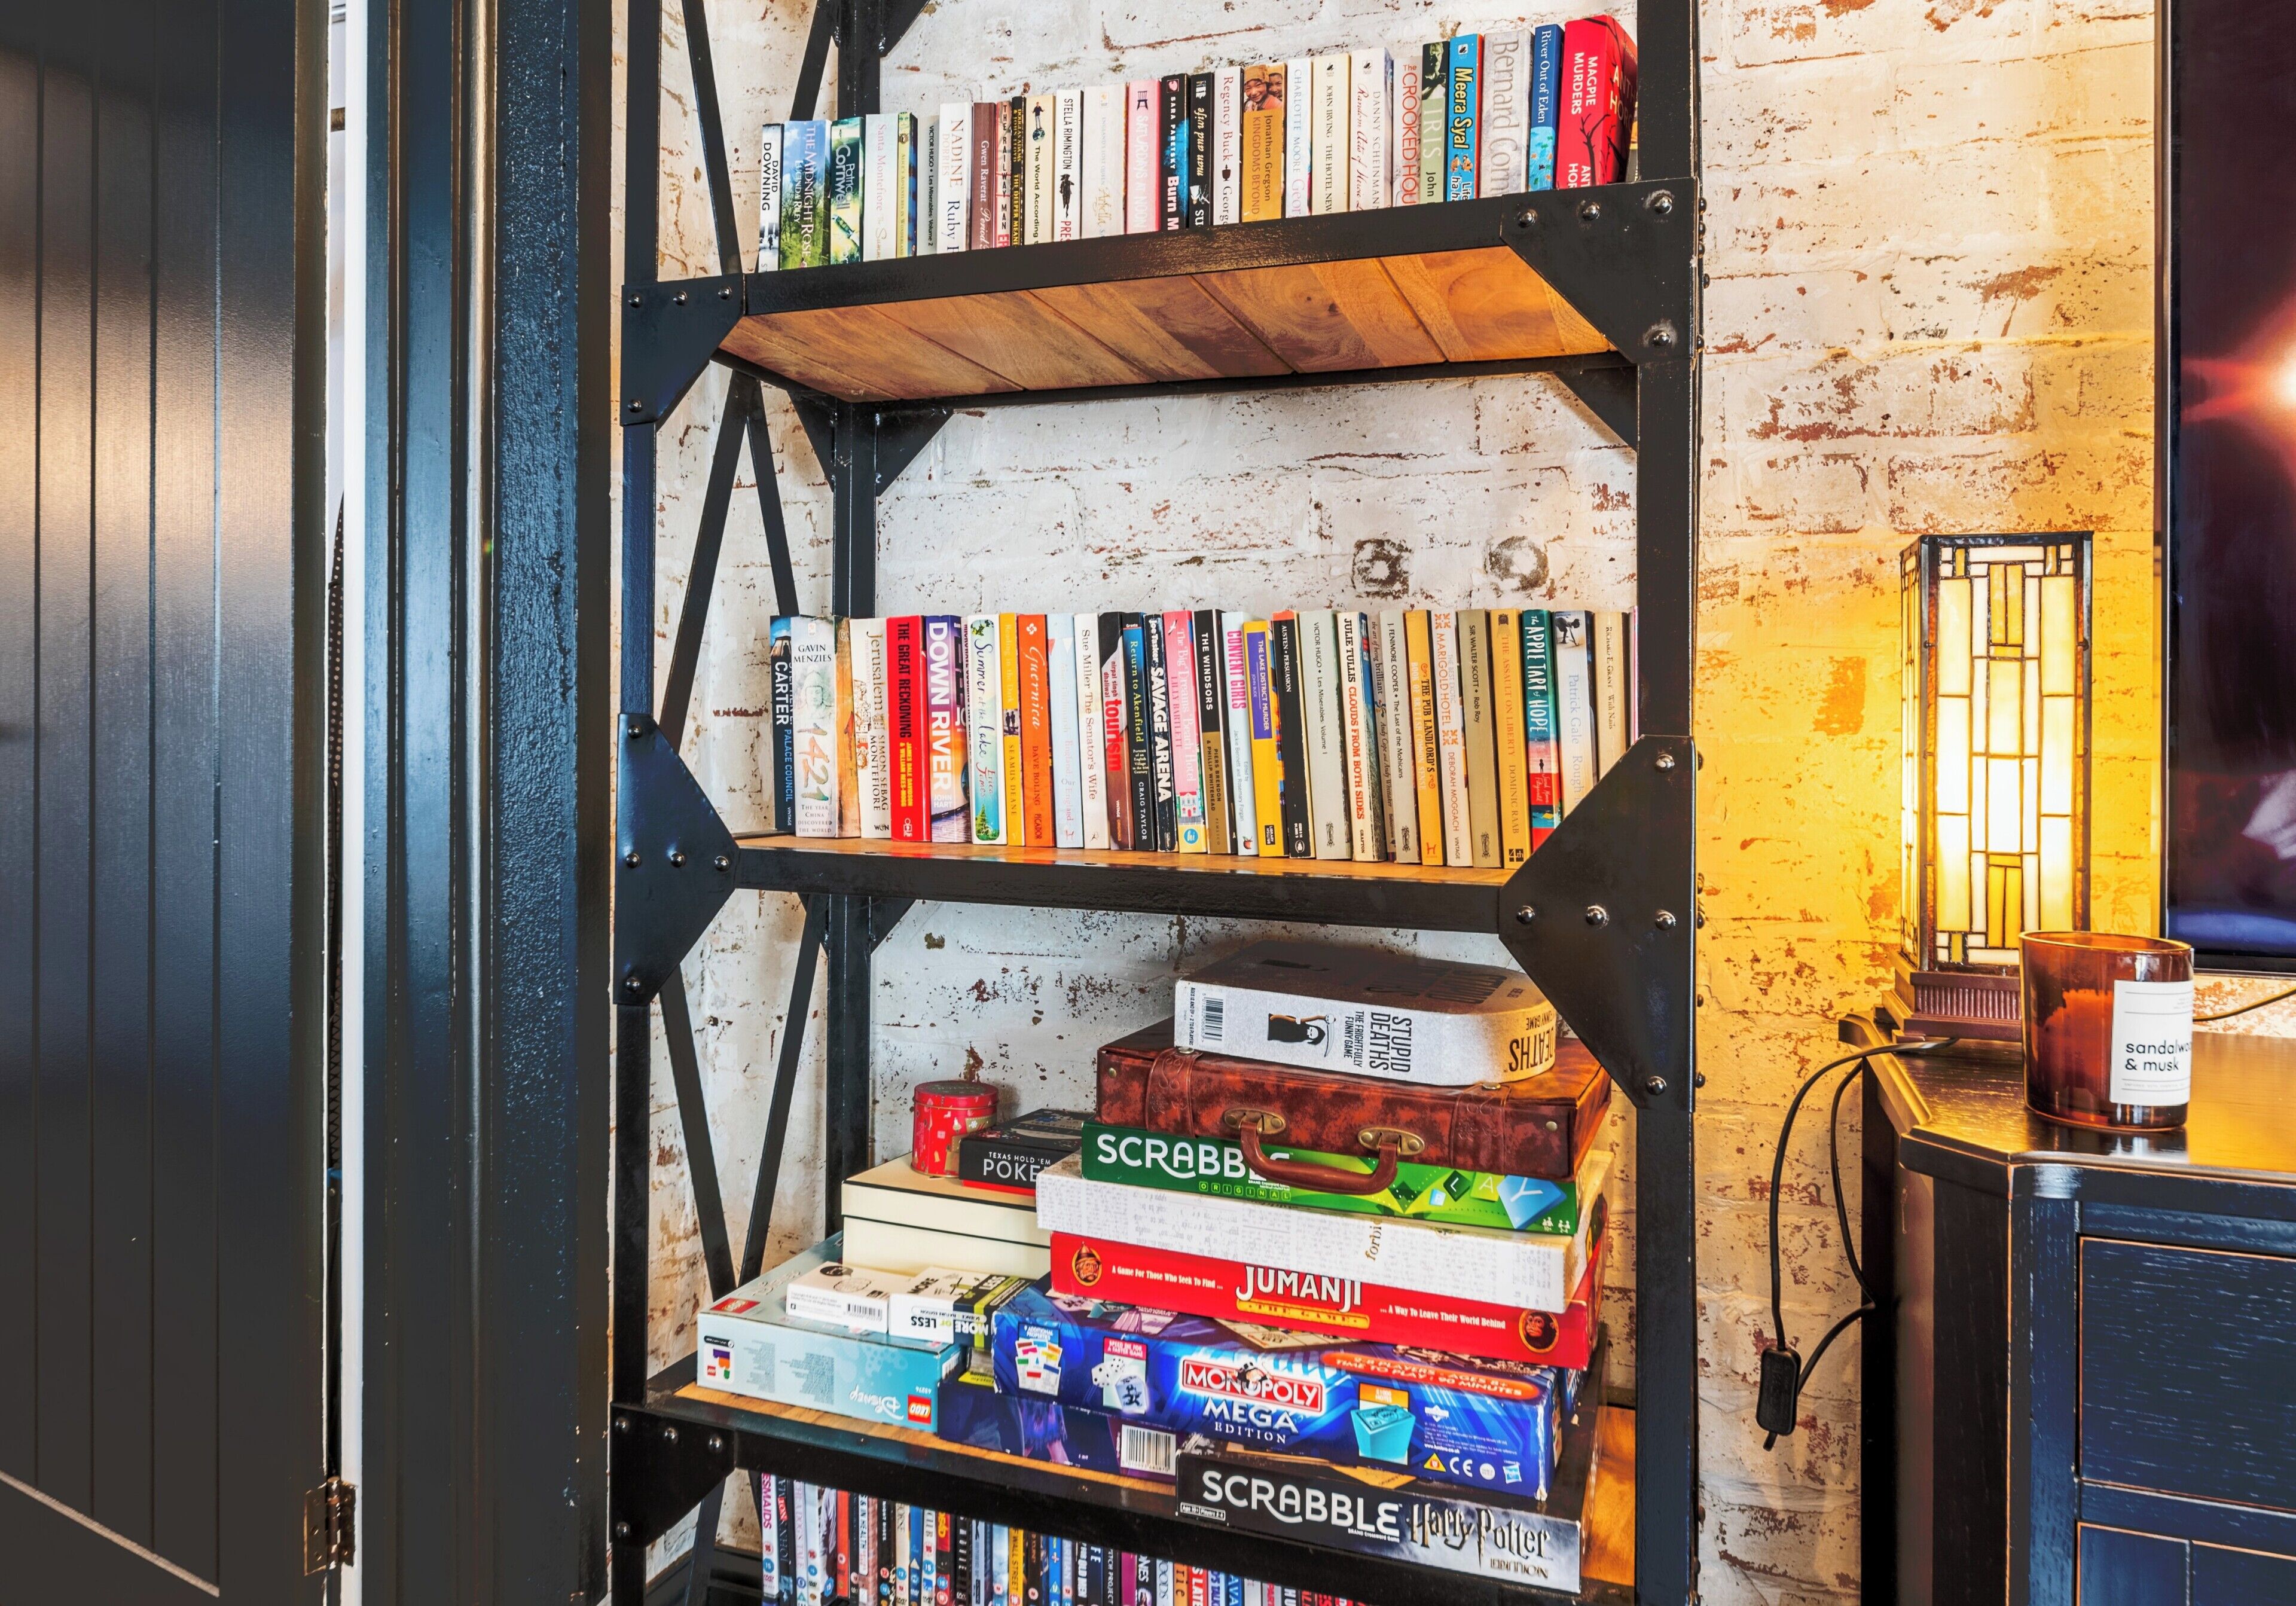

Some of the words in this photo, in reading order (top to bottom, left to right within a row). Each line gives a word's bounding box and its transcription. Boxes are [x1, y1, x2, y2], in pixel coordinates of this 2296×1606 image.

[1541, 30, 1552, 57] River
[1539, 83, 1549, 93] of
[1540, 61, 1550, 78] Out
[1571, 53, 1584, 115] MURDERS
[1586, 56, 1598, 106] MAGPIE
[1220, 77, 1233, 126] Regency
[1453, 67, 1474, 115] Meera
[1537, 94, 1549, 123] Eden
[1064, 99, 1073, 125] STELLA
[1402, 72, 1417, 160] CROOKED
[806, 125, 816, 149] THE
[1063, 129, 1072, 169] RIMINGTON
[1223, 132, 1233, 160] Buck
[1251, 117, 1261, 172] KINGDOMS
[1265, 115, 1273, 159] Jonathan
[1423, 108, 1442, 158] IRIS
[1451, 118, 1472, 149] Syal
[950, 120, 964, 187] NADINE
[762, 143, 771, 210] DOWNING
[804, 151, 814, 222] MIDNIGHT
[836, 145, 850, 209] Cornwell
[1168, 176, 1179, 212] Burn
[1251, 175, 1260, 214] BEYOND
[1262, 163, 1273, 201] Gregson
[1425, 172, 1436, 197] John
[942, 201, 960, 239] Ruby
[801, 224, 813, 257] ROSE
[898, 622, 909, 641] THE
[1344, 618, 1352, 646] JULIE
[1388, 630, 1397, 664] FENIMORE
[1525, 627, 1544, 660] APPLE
[794, 654, 832, 663] MENZIES
[868, 631, 883, 712] Jerusalem
[899, 644, 910, 674] GREAT
[929, 622, 949, 706] DOWN
[1228, 631, 1244, 675] CONVENT
[1345, 649, 1355, 682] TULLIS
[1436, 633, 1448, 691] MARIGOLD
[775, 662, 788, 725] CARTER
[1024, 647, 1045, 730] Guernica
[1134, 679, 1138, 688] to
[1203, 654, 1213, 710] WINDSORS
[1231, 679, 1247, 709] GIRLS
[1528, 664, 1547, 697] TART
[899, 679, 912, 738] RECKONING
[1134, 691, 1143, 743] Akenfield
[1150, 667, 1168, 732] SAVAGE
[1348, 686, 1358, 725] CLOUDS
[1440, 693, 1451, 726] HOTEL
[1528, 701, 1547, 732] HOPE
[931, 712, 951, 790] RIVER
[1105, 700, 1123, 771] tourism
[1351, 729, 1360, 757] FROM
[796, 723, 829, 801] 1421
[870, 735, 880, 811] MONTEFIORE
[1155, 740, 1172, 802] ARENA
[1354, 760, 1362, 787] BOTH
[1448, 752, 1457, 787] DEBORAH
[1087, 772, 1095, 799] Wife
[1355, 790, 1365, 819] SIDES
[1345, 1016, 1354, 1039] FUNNY
[1355, 1010, 1364, 1023] THE
[1344, 1041, 1353, 1060] GAME
[1354, 1024, 1363, 1068] FRIGHTFULLY
[1369, 1012, 1391, 1071] DEATHS
[1393, 1015, 1412, 1073] STUPID
[2125, 1059, 2137, 1070] &
[2144, 1058, 2179, 1071] musk
[984, 1158, 1040, 1181] POKE
[989, 1152, 1011, 1161] TEXAS
[1097, 1134, 1290, 1181] SCRABB
[1201, 1182, 1289, 1199] ORIGINAL
[1118, 1267, 1134, 1277] Game
[1135, 1269, 1145, 1278] For
[1147, 1270, 1163, 1280] Those
[1164, 1272, 1177, 1281] Who
[1178, 1275, 1192, 1284] Seek
[1194, 1277, 1201, 1286] To
[1202, 1278, 1216, 1289] Find
[1235, 1265, 1363, 1312] JUMANJI
[911, 1317, 937, 1329] LESS
[955, 1320, 989, 1336] MORE
[1388, 1305, 1394, 1314] A
[1395, 1306, 1408, 1317] Way
[1410, 1308, 1418, 1316] To
[1419, 1309, 1439, 1320] Leave
[1440, 1312, 1458, 1322] Their
[1460, 1315, 1480, 1326] World
[1482, 1318, 1506, 1329] Behind
[1186, 1366, 1318, 1406] MONOPOLY
[1336, 1359, 1364, 1369] TIME
[1370, 1363, 1388, 1373] TO
[1459, 1380, 1522, 1396] MINUTES
[909, 1405, 930, 1416] LEGO
[1202, 1399, 1299, 1436] MEGA
[1214, 1421, 1287, 1445] EDITION
[1202, 1471, 1400, 1536] SCRABBLE
[1407, 1503, 1474, 1550] Harry
[1476, 1509, 1550, 1570] Potter
